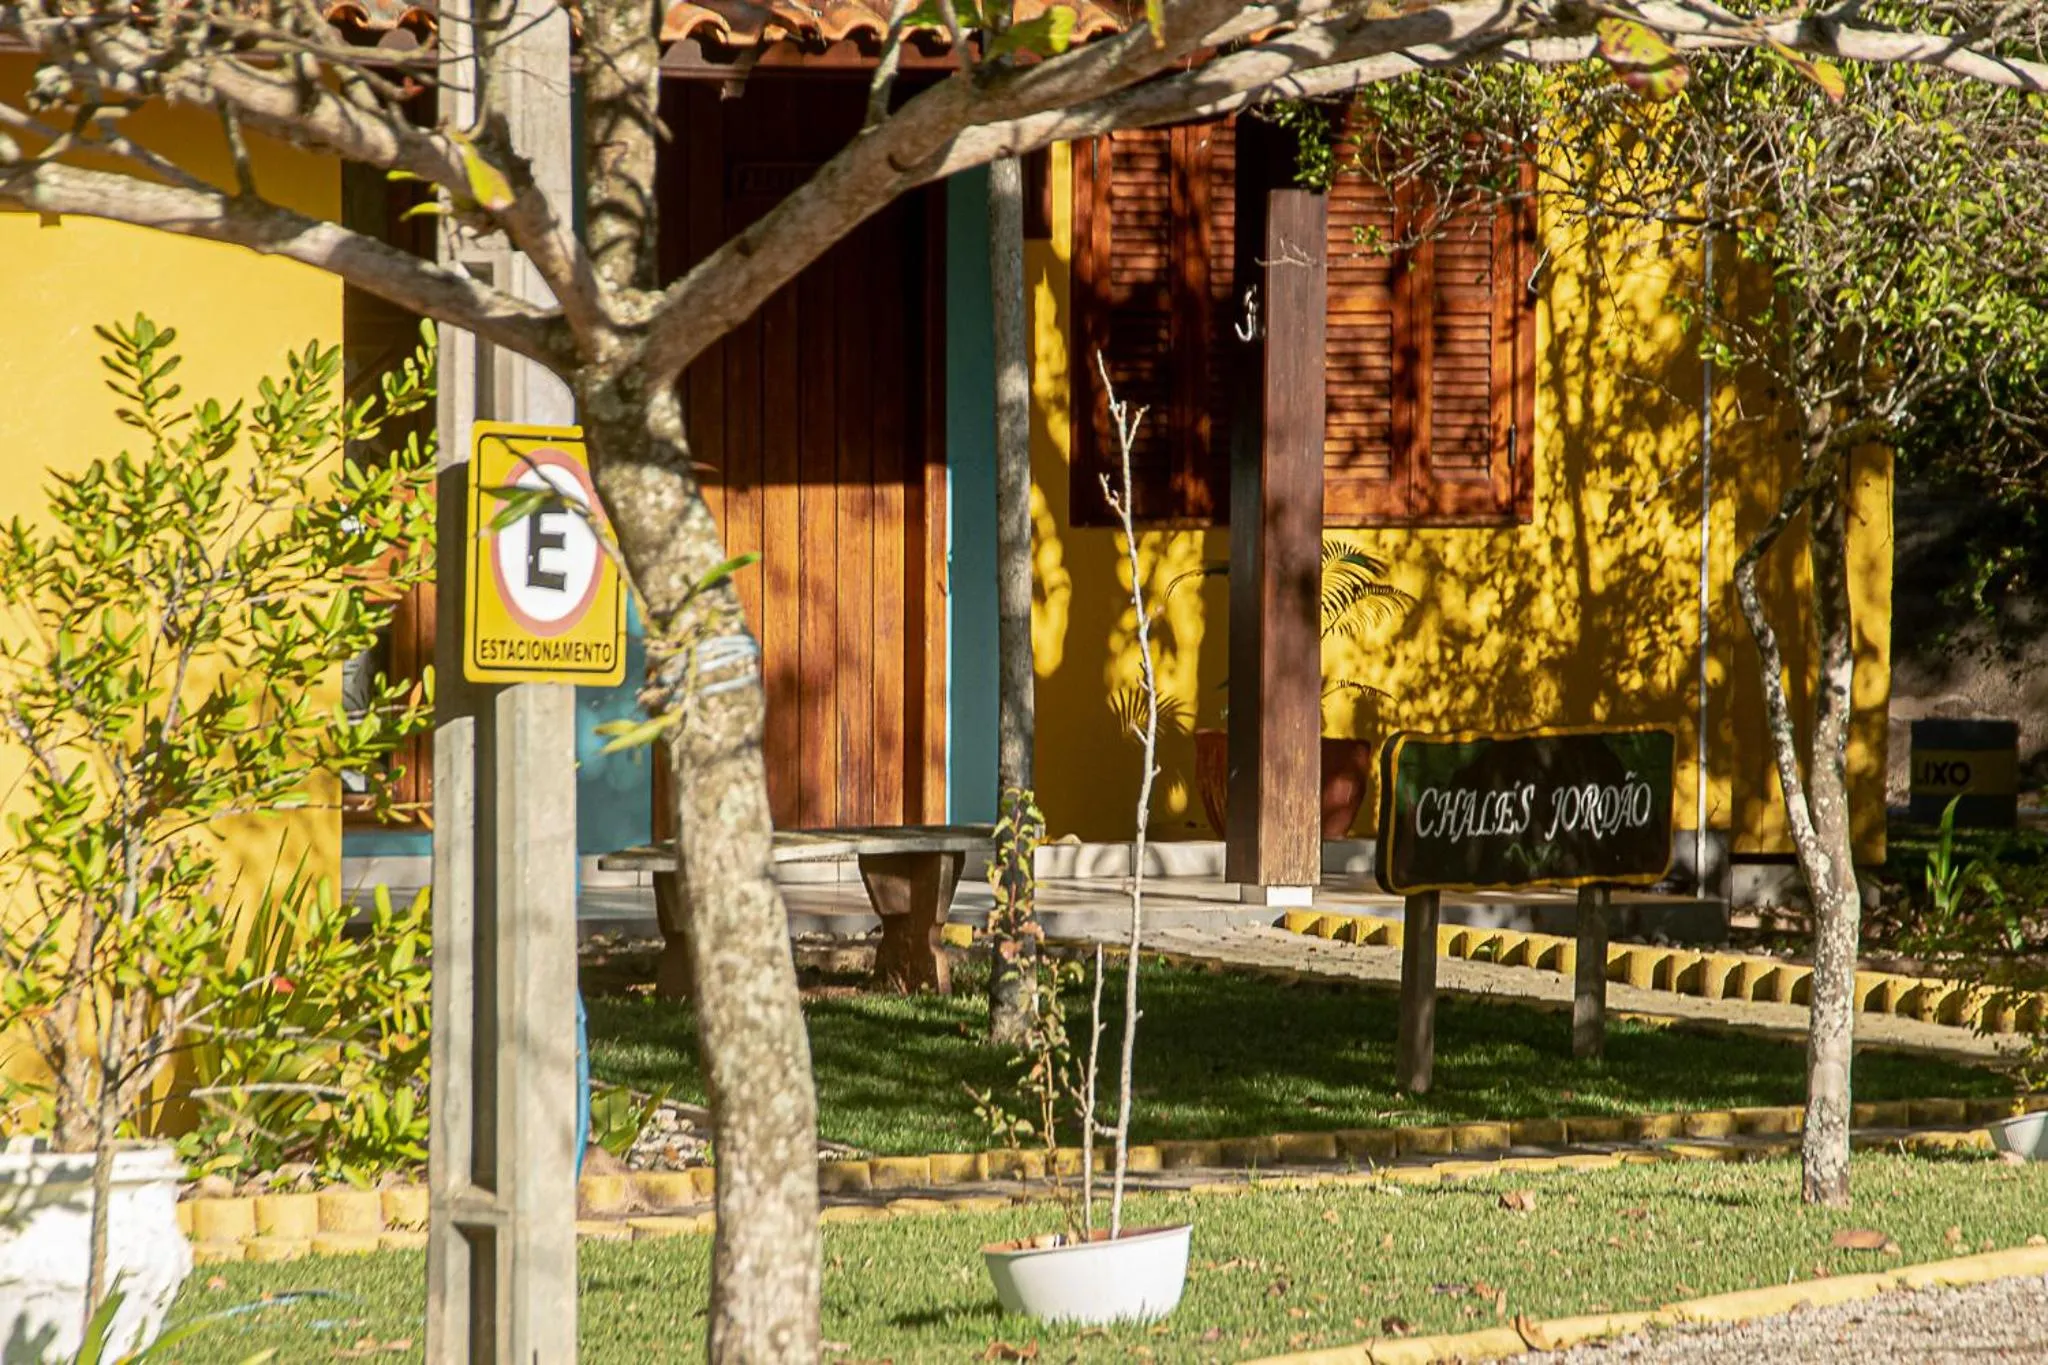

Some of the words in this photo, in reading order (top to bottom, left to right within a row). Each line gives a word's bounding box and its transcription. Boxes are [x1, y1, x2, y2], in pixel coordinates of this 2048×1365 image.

[527, 494, 568, 592] E
[480, 639, 613, 663] ESTACIONAMENTO
[1545, 771, 1651, 841] JORDÃO
